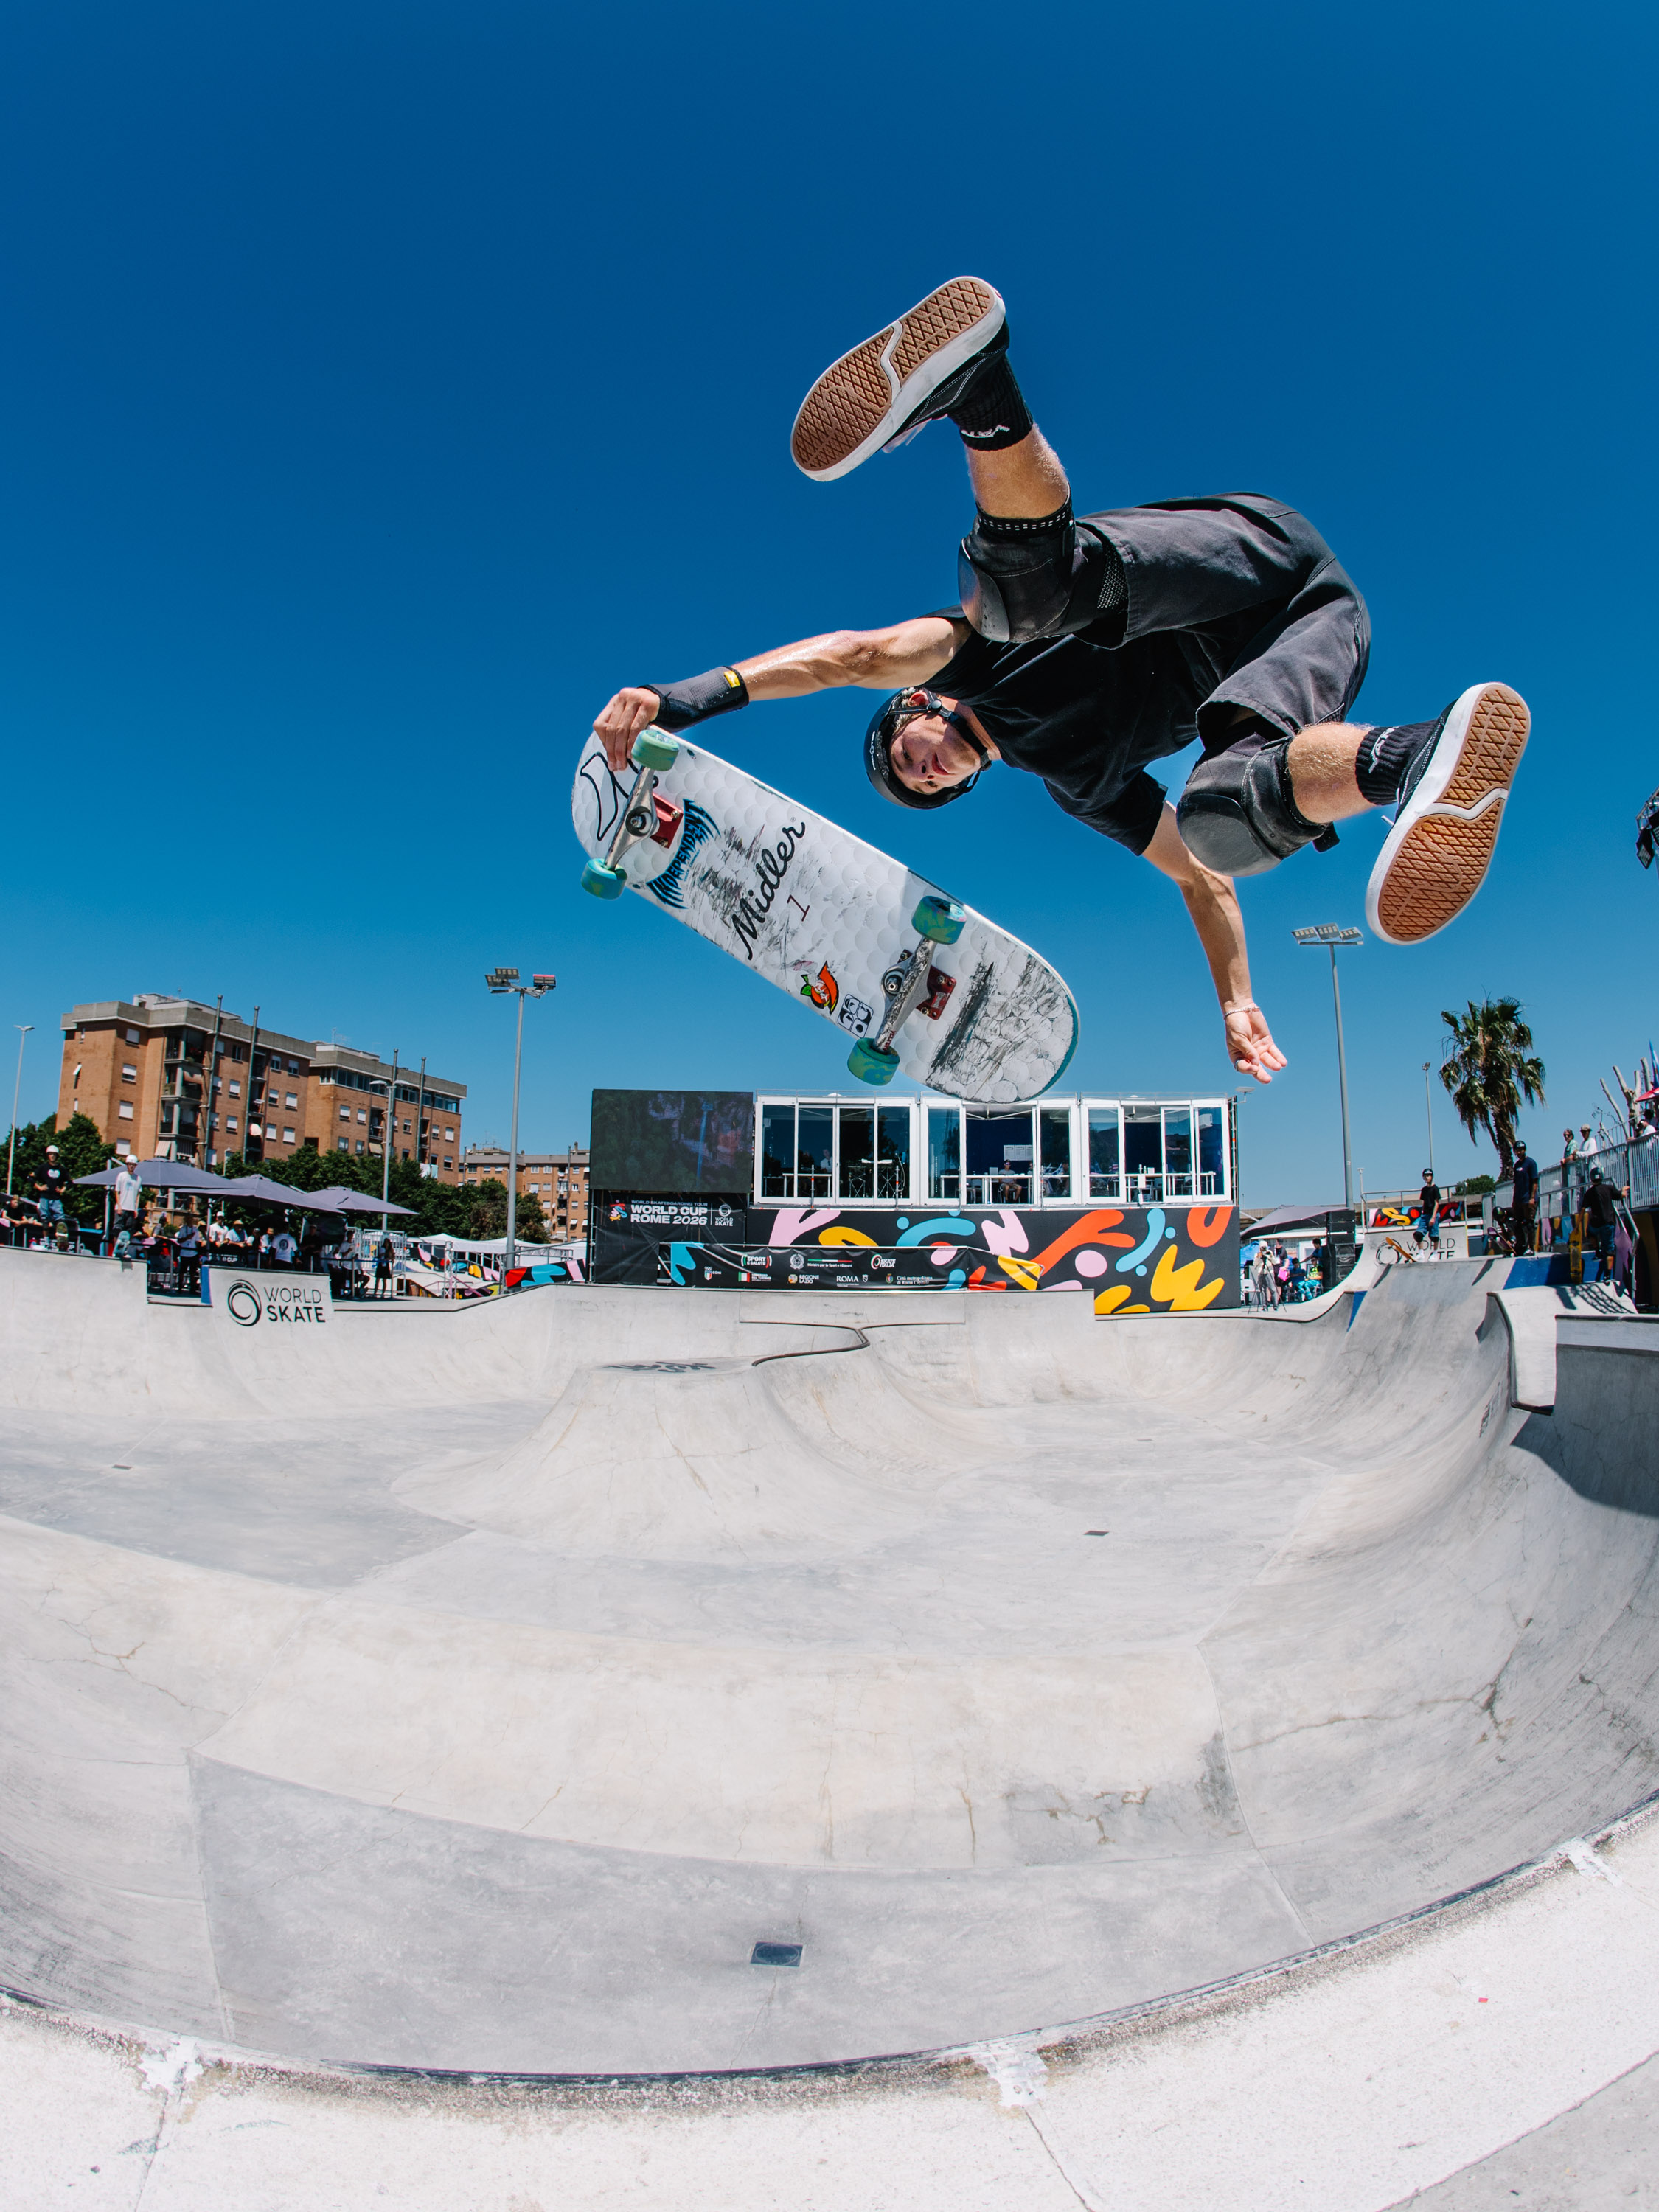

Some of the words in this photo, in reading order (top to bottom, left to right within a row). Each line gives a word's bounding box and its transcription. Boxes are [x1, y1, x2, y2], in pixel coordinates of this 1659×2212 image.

[646, 798, 721, 909] INDEPENDENT
[732, 822, 805, 960] Midler
[630, 1204, 678, 1215] WORLD
[680, 1206, 708, 1216] CUP
[630, 1214, 670, 1224] ROME
[672, 1215, 708, 1225] 2026
[264, 1287, 321, 1304] WORLD
[267, 1305, 326, 1323] SKATE
